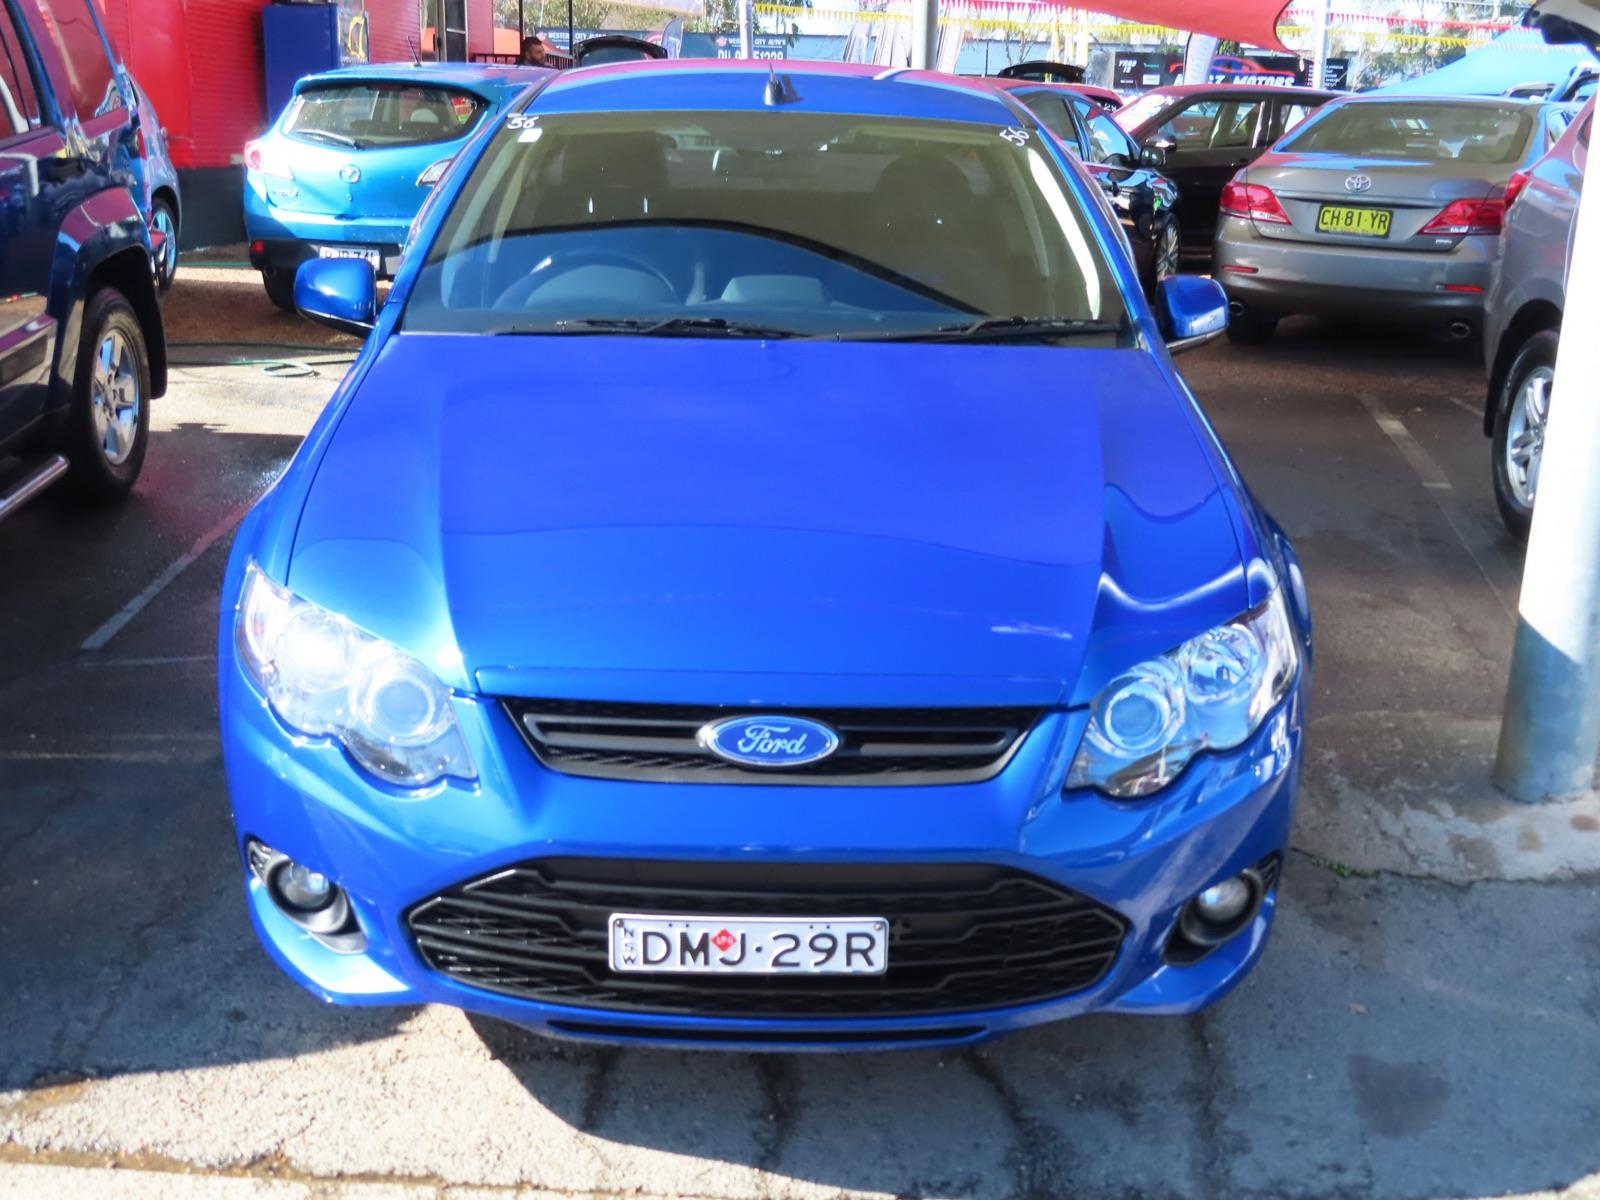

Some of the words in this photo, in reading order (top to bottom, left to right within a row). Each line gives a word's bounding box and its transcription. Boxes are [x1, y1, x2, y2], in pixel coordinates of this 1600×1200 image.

[1233, 75, 1295, 87] MOTORS
[507, 115, 540, 129] 56
[999, 125, 1030, 147] 56
[737, 724, 808, 754] Ford
